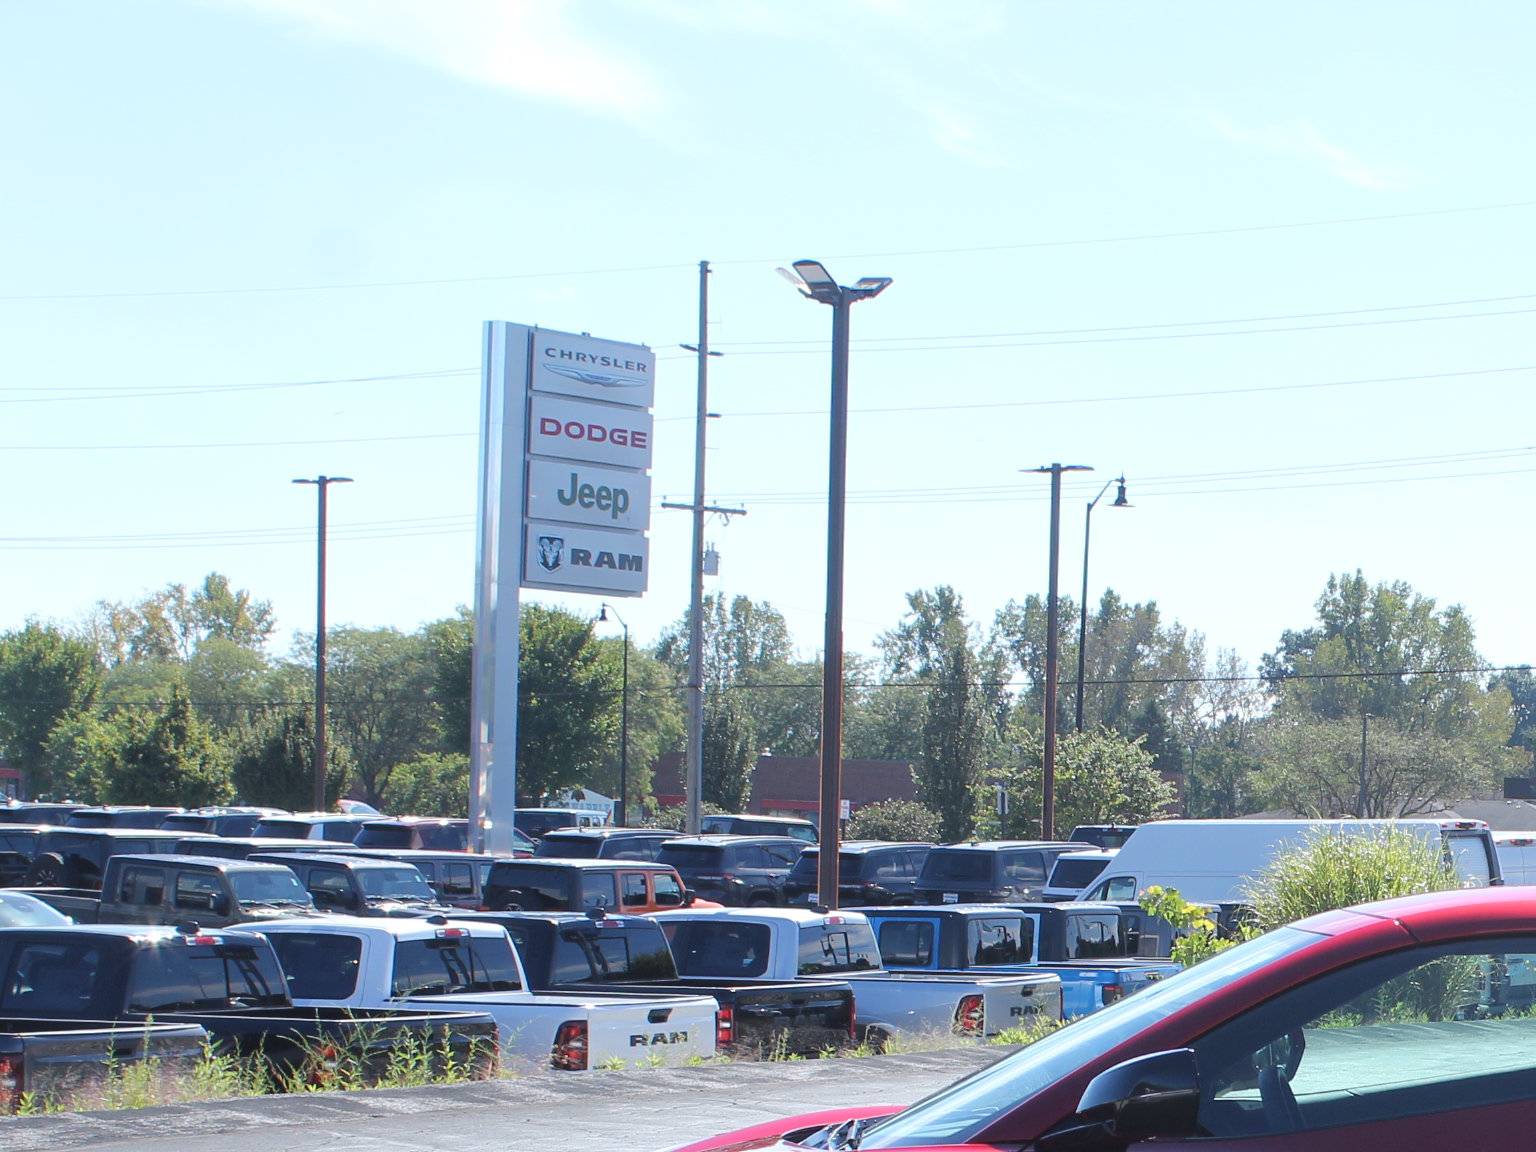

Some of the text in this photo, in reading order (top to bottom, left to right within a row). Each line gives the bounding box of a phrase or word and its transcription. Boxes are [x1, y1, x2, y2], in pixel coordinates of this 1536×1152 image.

[545, 347, 648, 373] CHRYSLER
[540, 417, 647, 449] DODGE
[557, 473, 629, 519] Jeep
[570, 548, 643, 573] RAM
[629, 1031, 688, 1047] RAM
